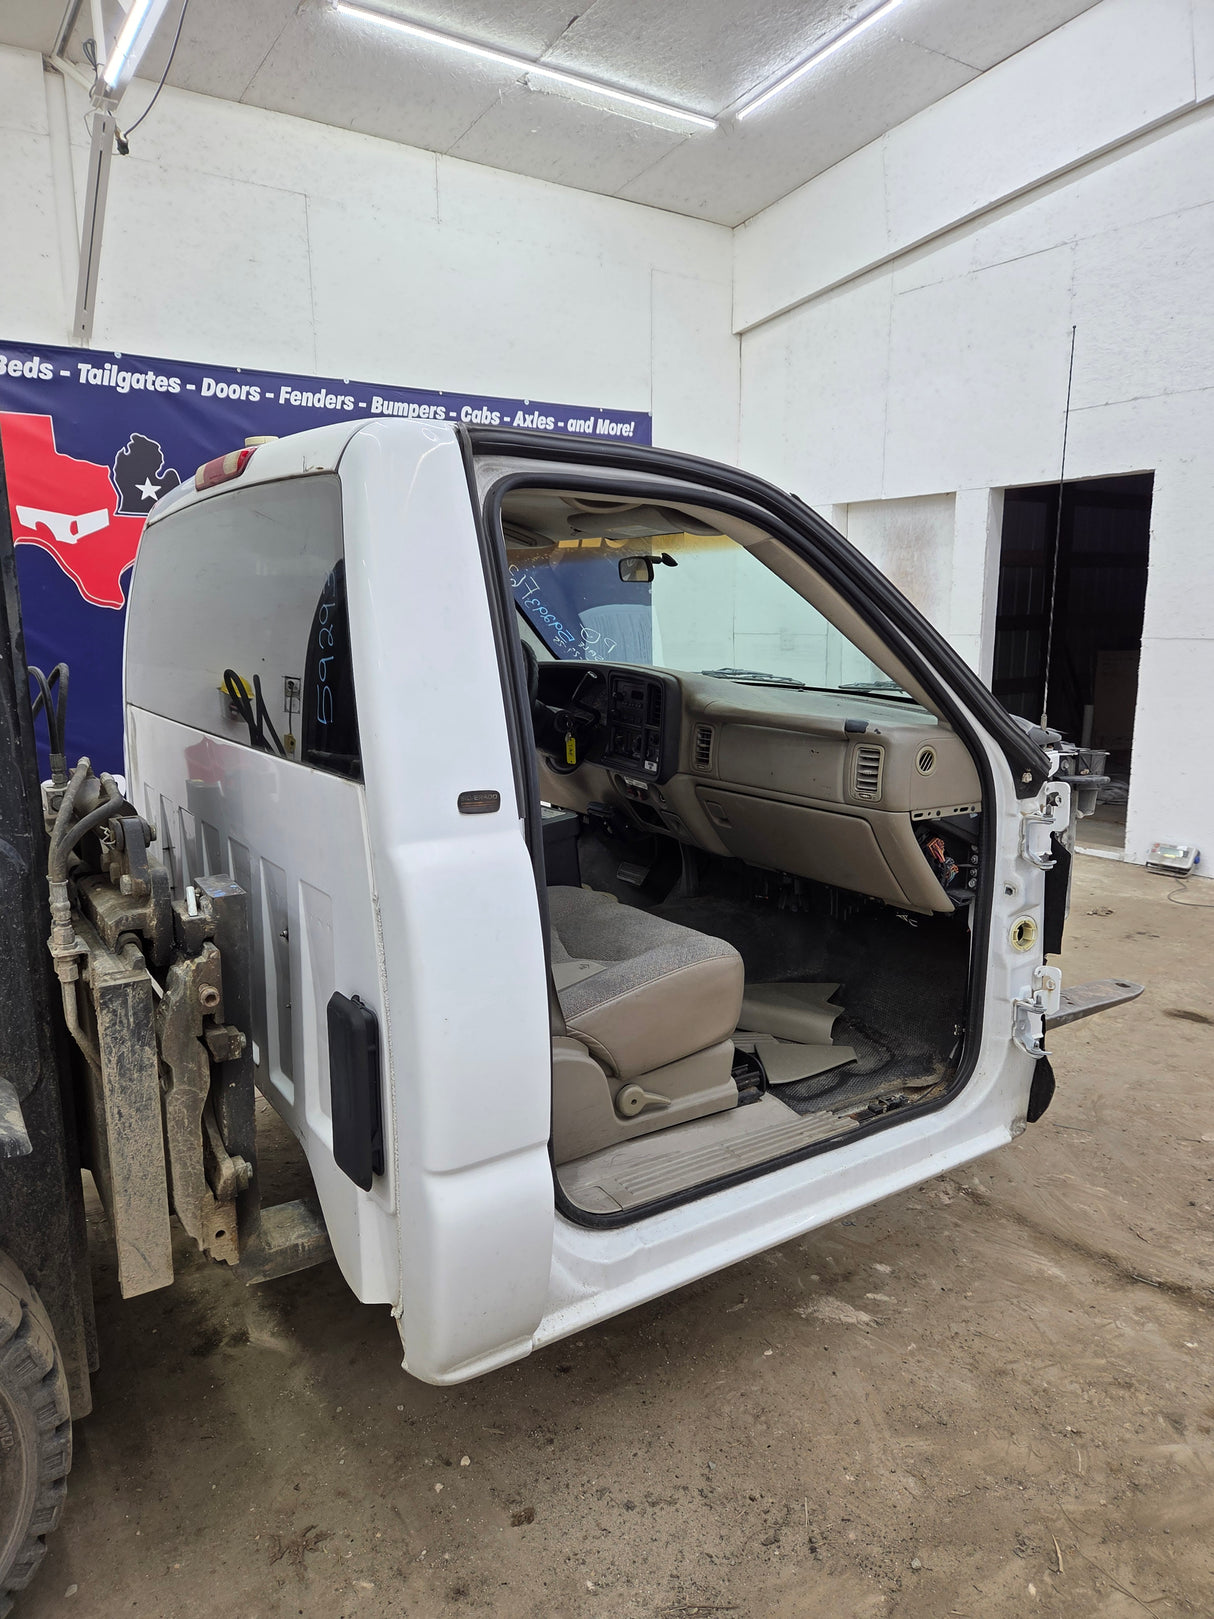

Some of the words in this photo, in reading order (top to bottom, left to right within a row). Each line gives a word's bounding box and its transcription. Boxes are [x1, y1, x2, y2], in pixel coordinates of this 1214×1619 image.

[78, 362, 181, 394] Tailgates
[201, 378, 261, 402] Doors
[279, 386, 354, 411] Fenders
[371, 396, 446, 420] Bumpers
[460, 405, 500, 425] Cabs
[513, 410, 555, 431] Axles
[567, 417, 594, 434] and
[596, 418, 635, 437] More!
